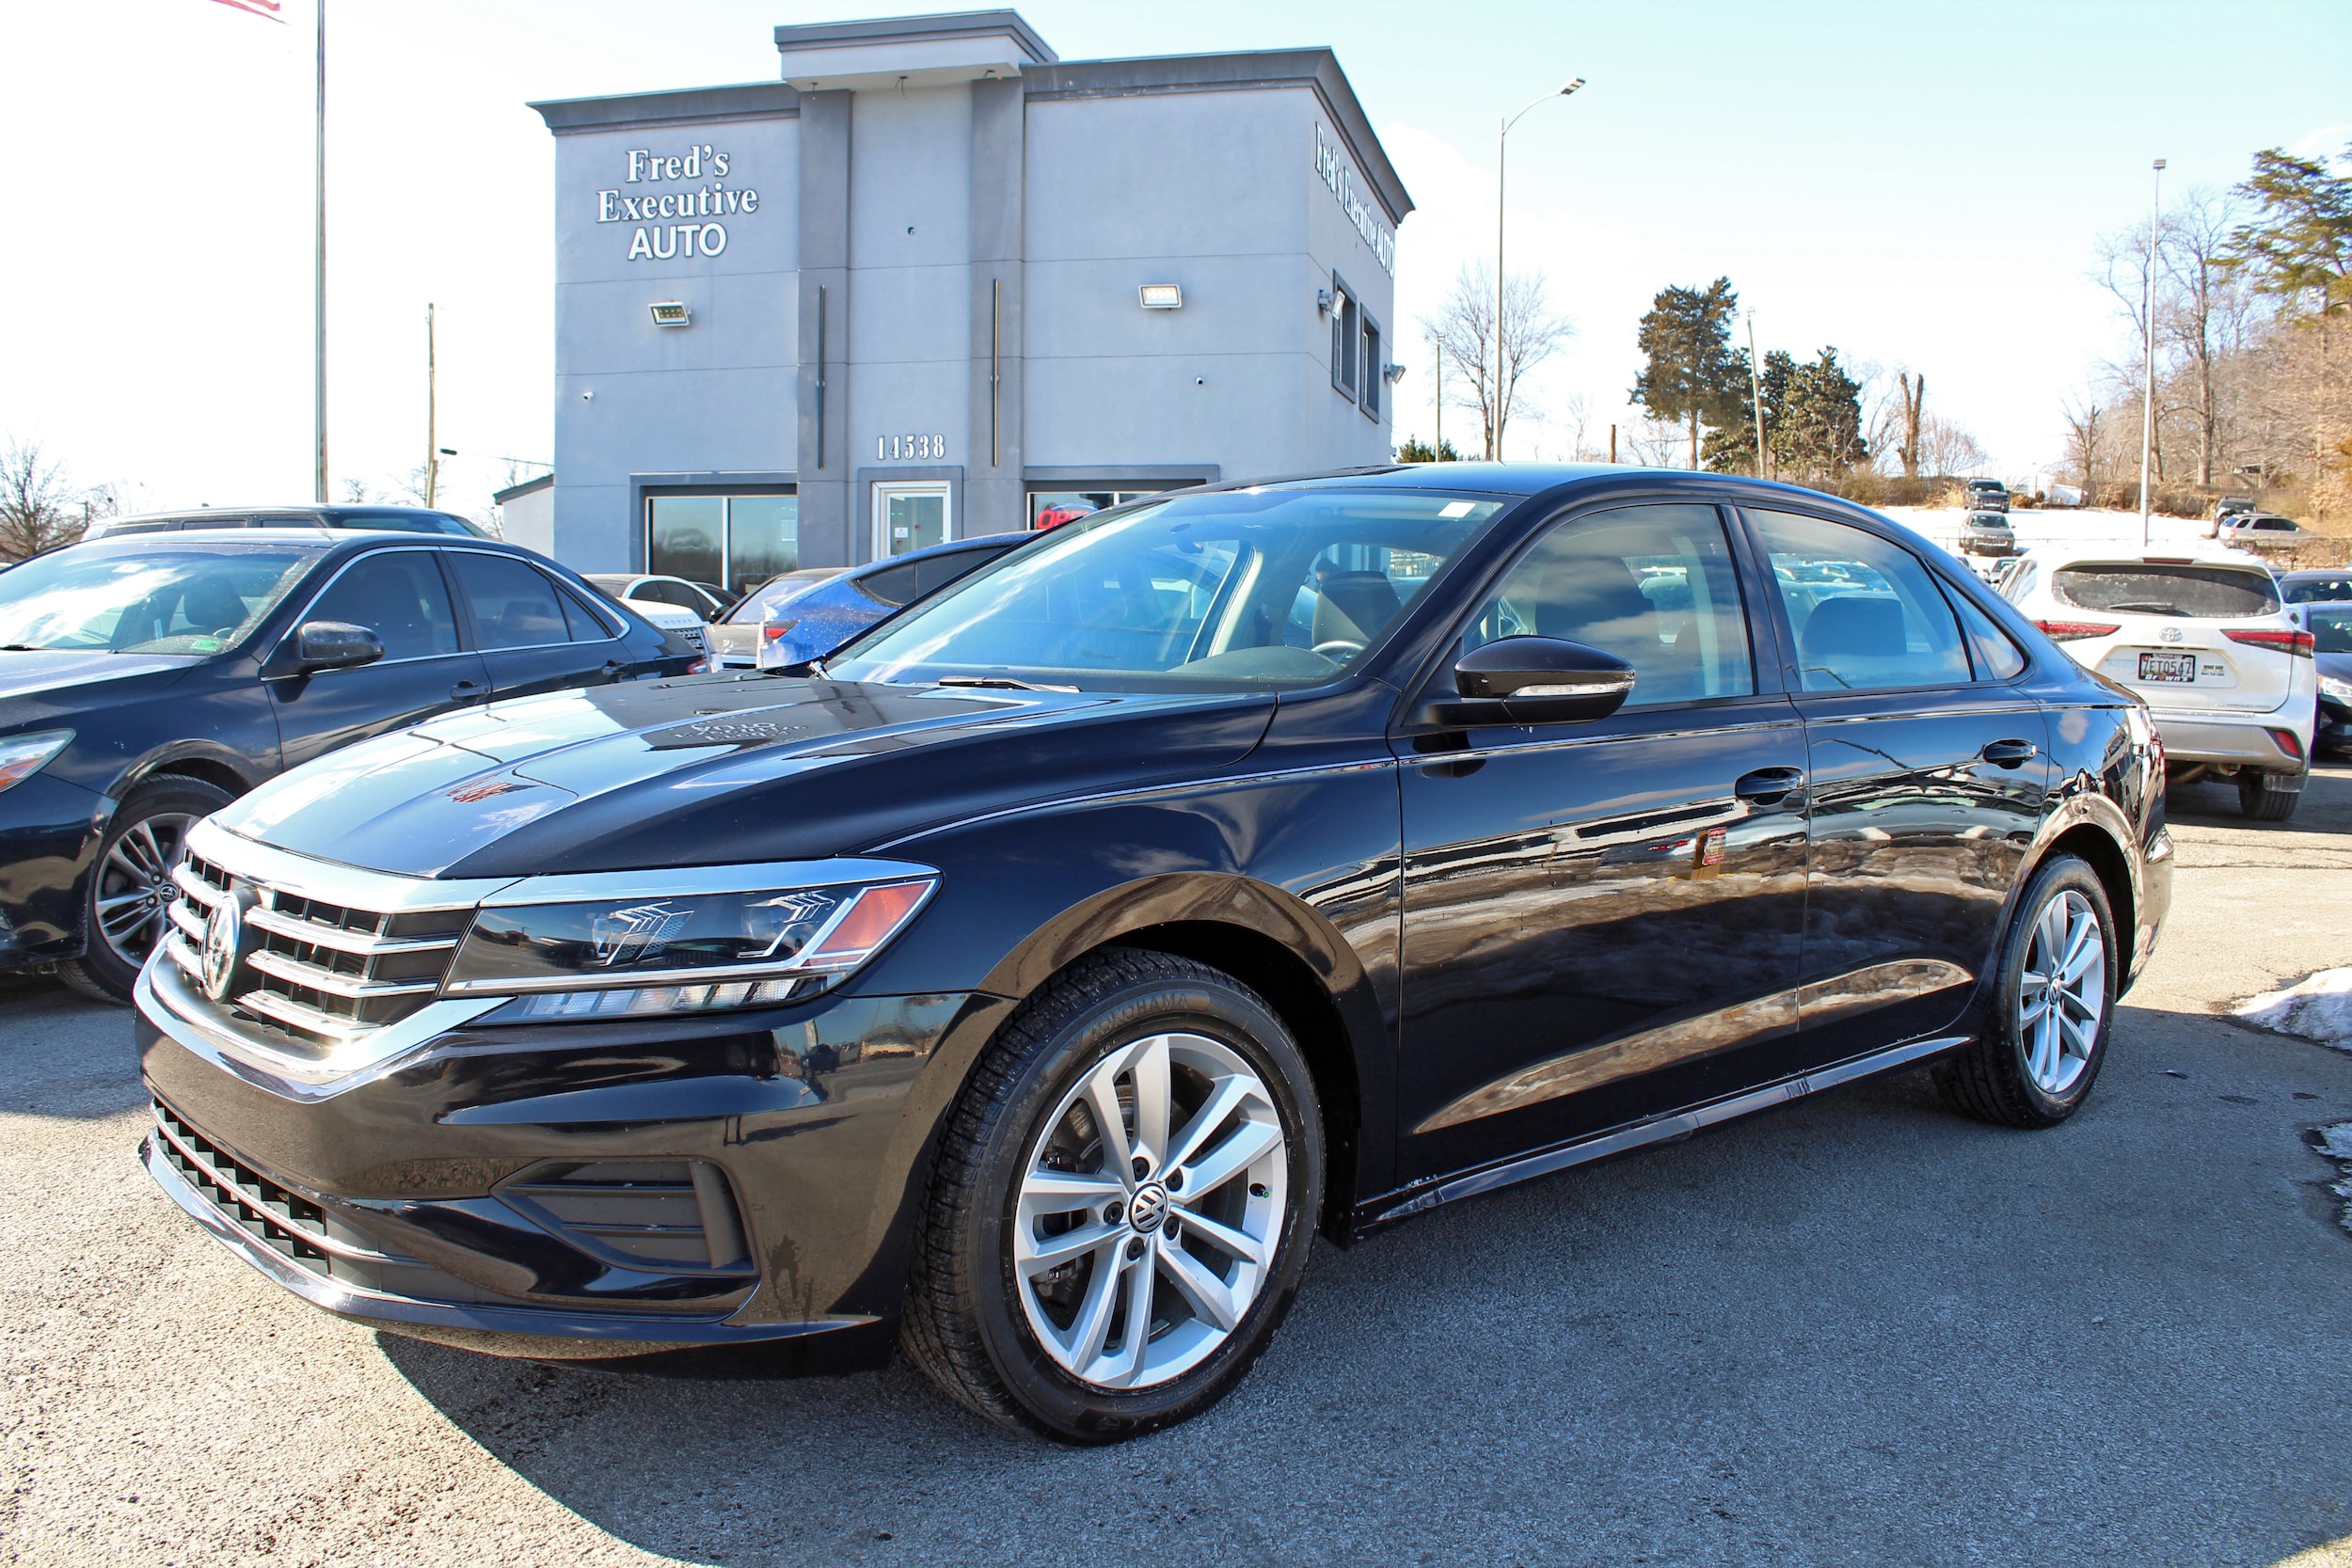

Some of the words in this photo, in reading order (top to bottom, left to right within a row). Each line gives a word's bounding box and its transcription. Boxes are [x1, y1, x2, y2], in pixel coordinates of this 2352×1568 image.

[625, 144, 729, 182] Fred's
[596, 182, 758, 223] Executive
[1314, 120, 1343, 203] Fred's
[1375, 221, 1394, 279] AUTO
[628, 222, 727, 261] AUTO
[877, 434, 946, 460] 14538
[1089, 992, 1190, 1041] YOKOHAMA
